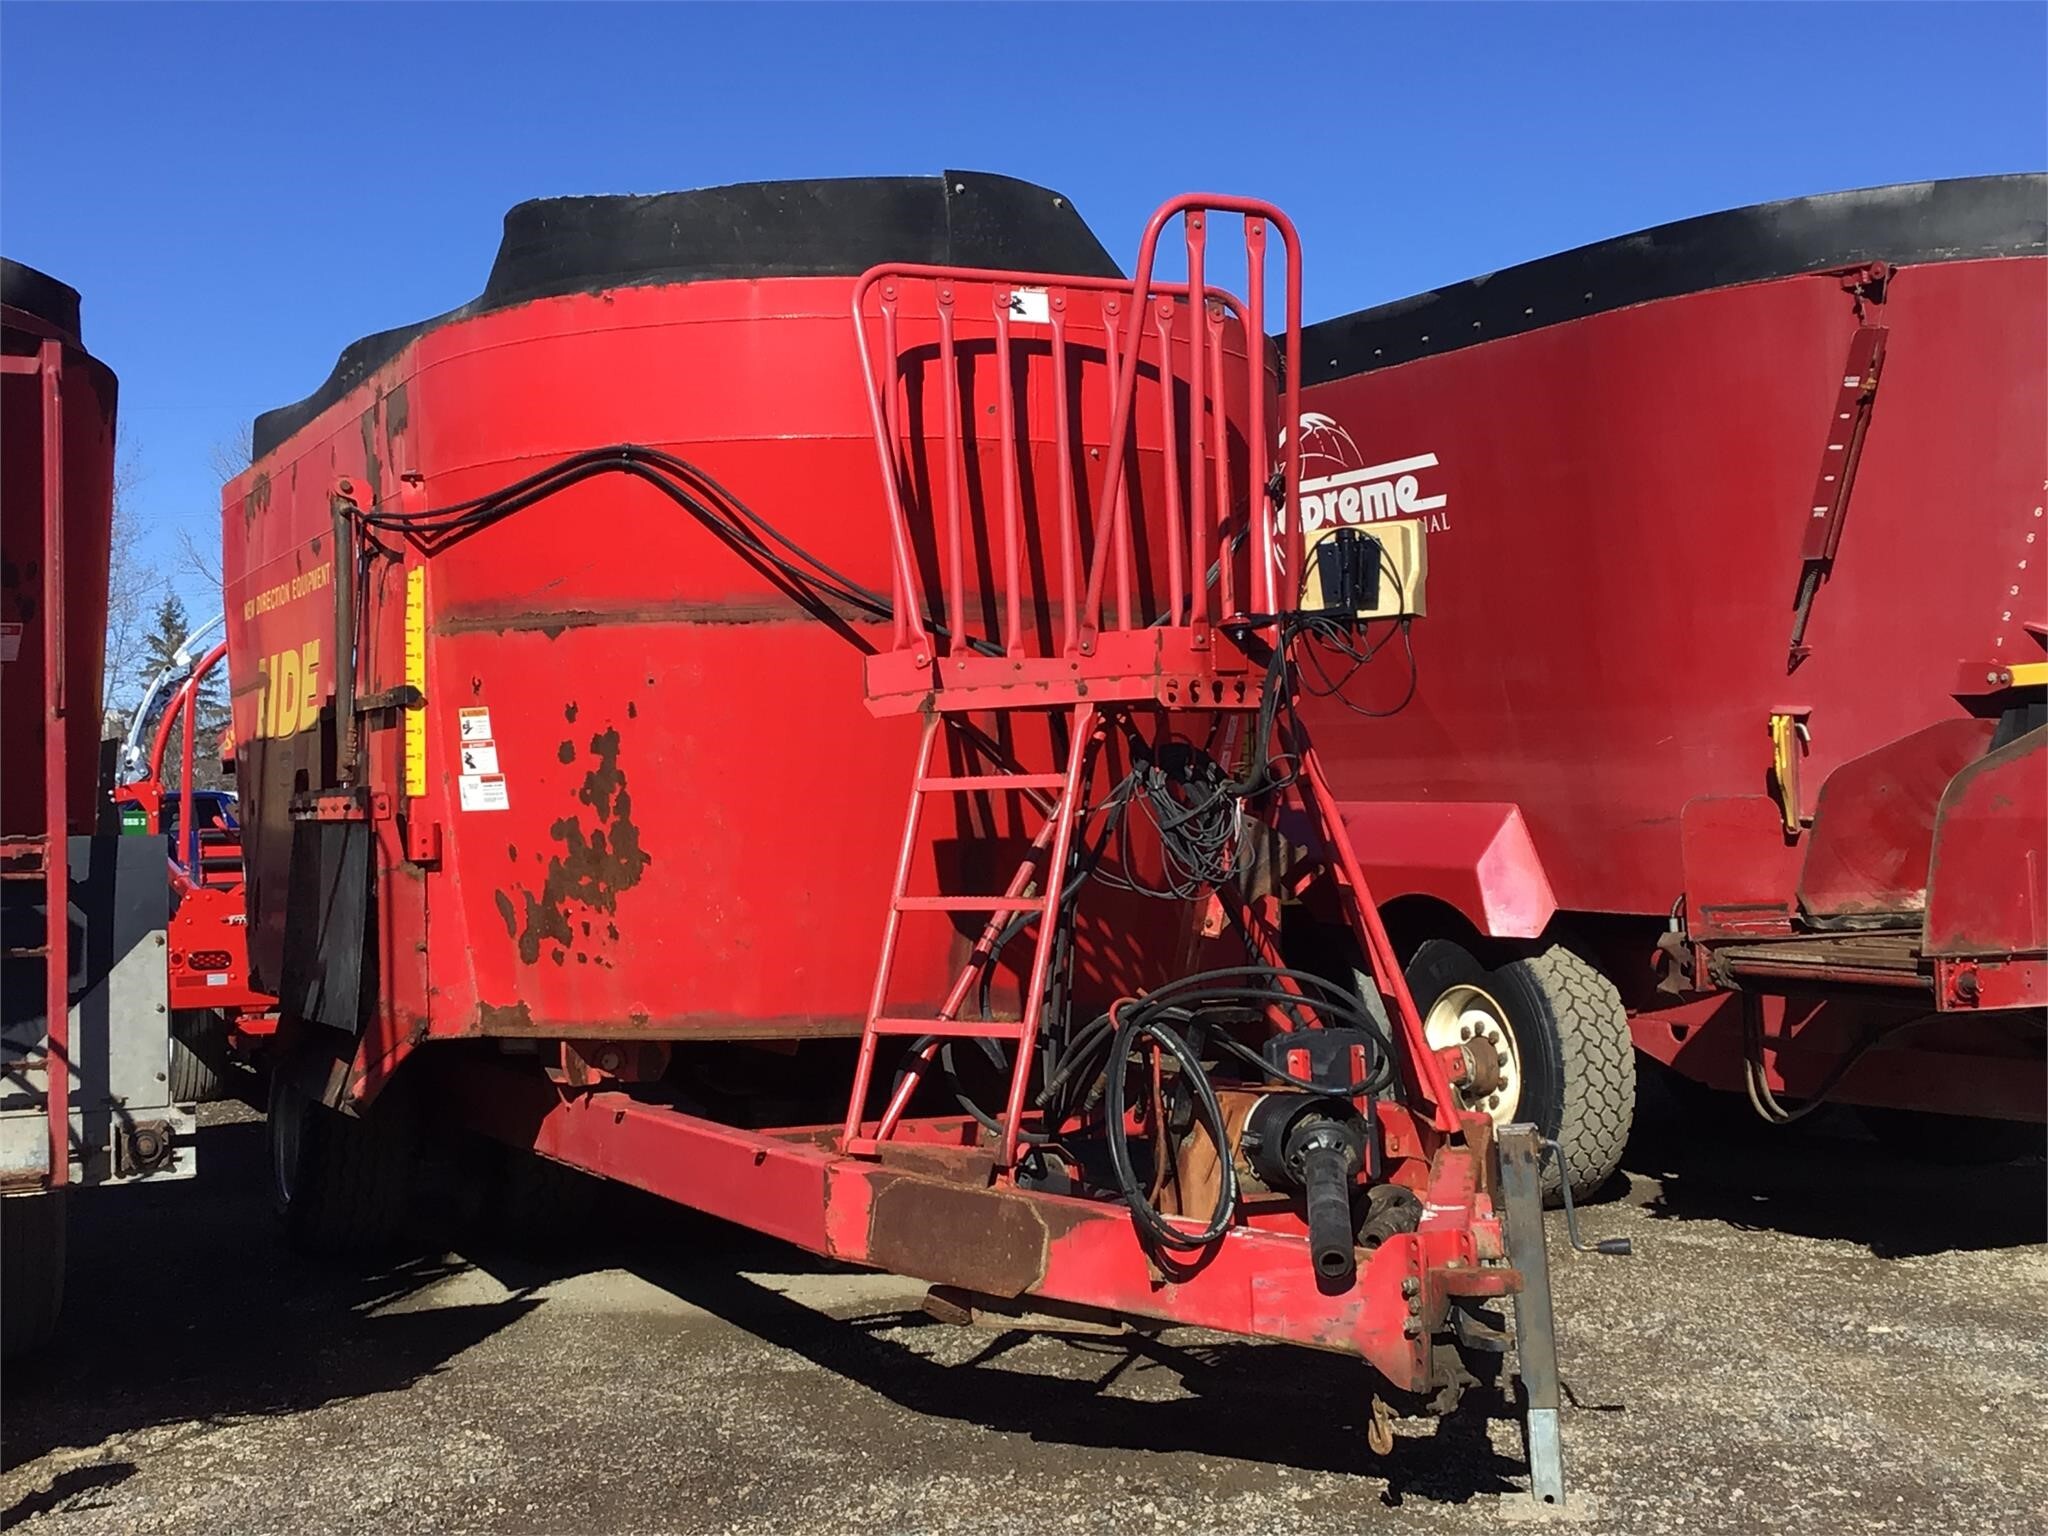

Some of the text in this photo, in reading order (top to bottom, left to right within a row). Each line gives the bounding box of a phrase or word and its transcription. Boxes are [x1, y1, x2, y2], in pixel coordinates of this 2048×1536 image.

[1273, 474, 1447, 534] preme
[2034, 507, 2043, 518] 6
[2026, 532, 2036, 544] 5
[2018, 559, 2027, 570] 4
[256, 582, 290, 616] DIRECTION
[292, 562, 331, 600] EQUIPMENT
[2010, 584, 2019, 596] 3
[2002, 610, 2011, 622] 2
[1996, 636, 2003, 647] 1
